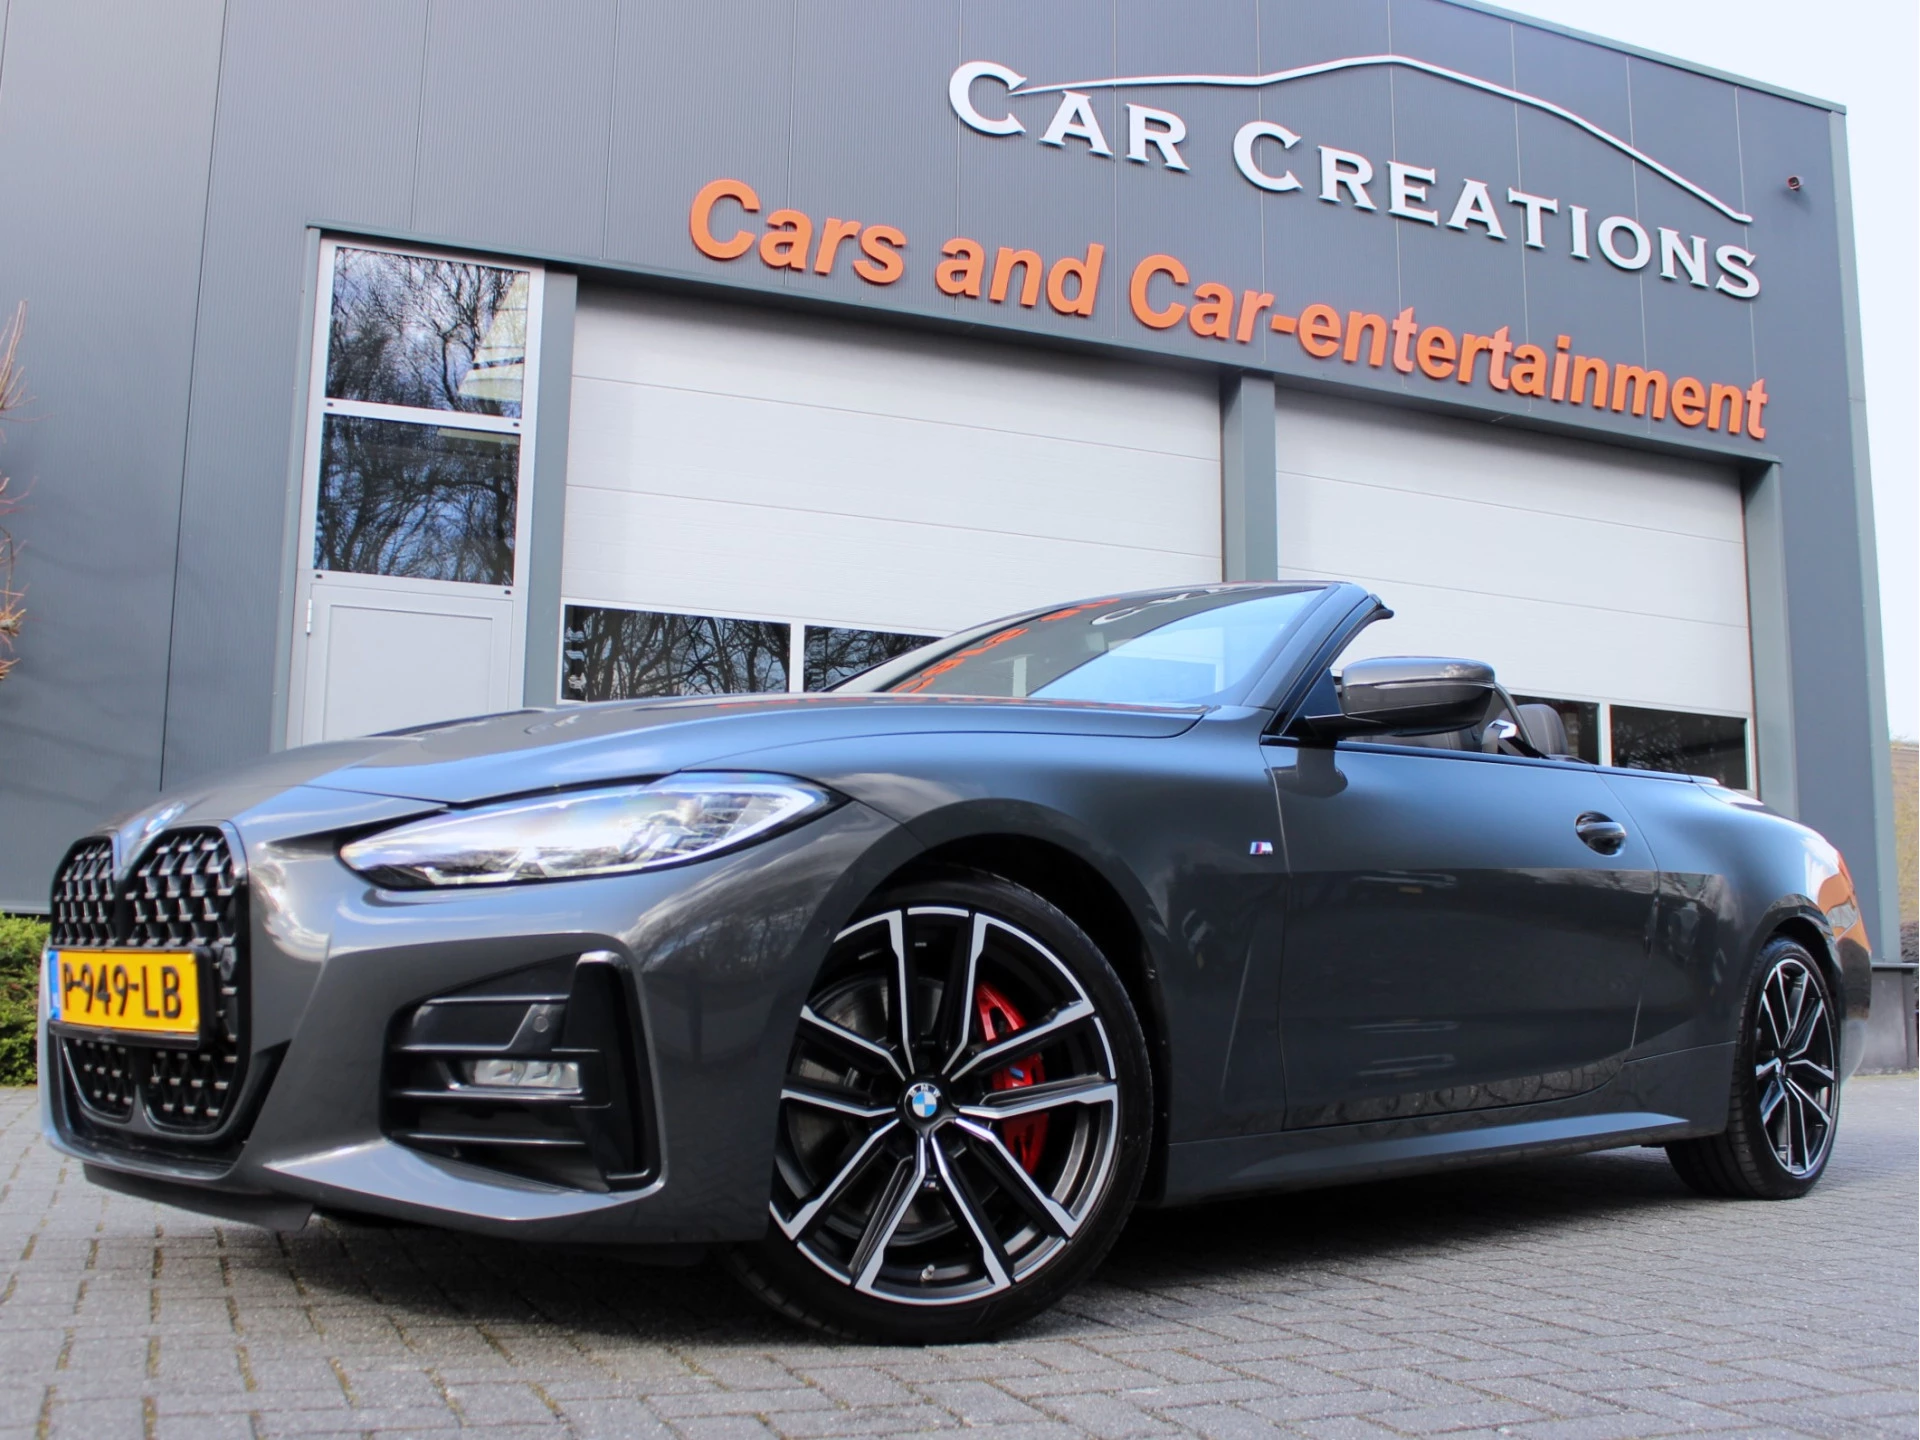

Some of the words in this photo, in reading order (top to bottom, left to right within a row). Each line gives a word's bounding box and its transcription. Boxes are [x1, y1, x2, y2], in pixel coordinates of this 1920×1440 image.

[949, 62, 1190, 172] CAR
[1233, 121, 1759, 299] CREATIONS
[690, 178, 906, 284] Cars
[936, 238, 1105, 317] and
[1130, 254, 1768, 440] Car-entertainment
[63, 962, 182, 1018] P-949-LB
